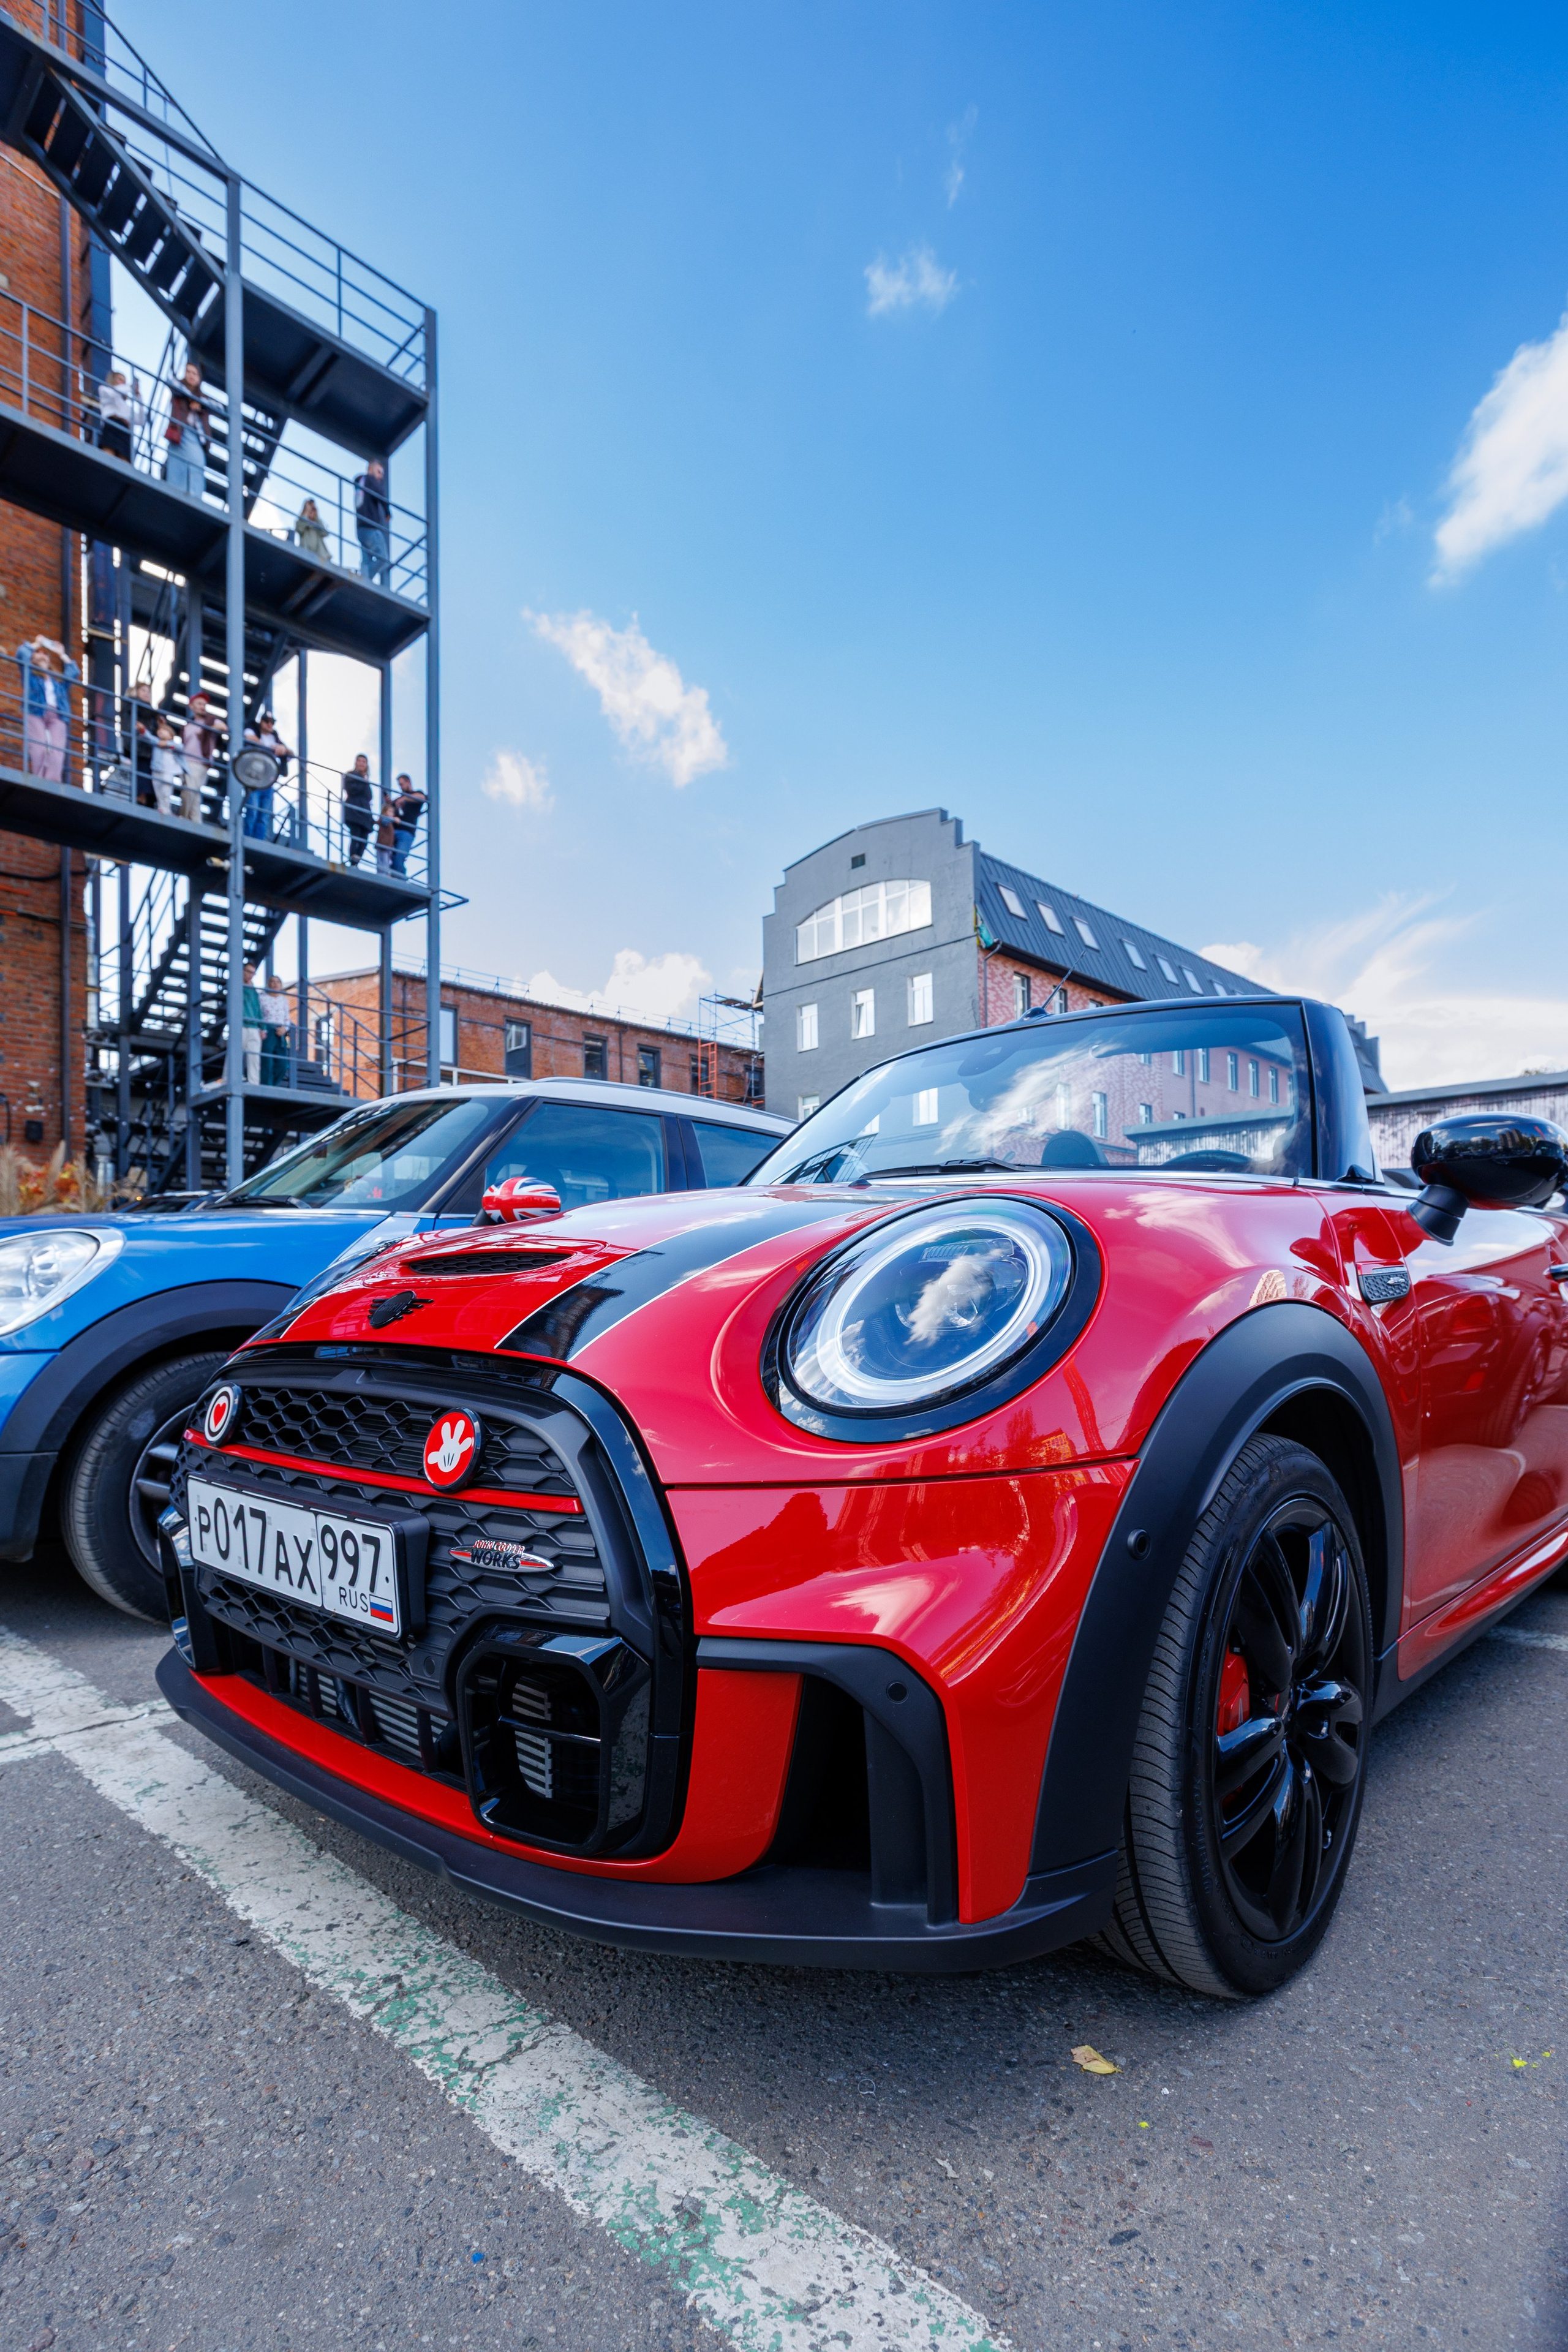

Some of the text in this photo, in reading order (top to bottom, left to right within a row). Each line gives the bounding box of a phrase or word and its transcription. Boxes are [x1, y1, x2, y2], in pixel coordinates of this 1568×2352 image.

[321, 1525, 380, 1593] 997
[471, 1548, 522, 1570] WORKS
[473, 1539, 525, 1555] JOHN COOPER
[339, 1586, 369, 1613] RUS
